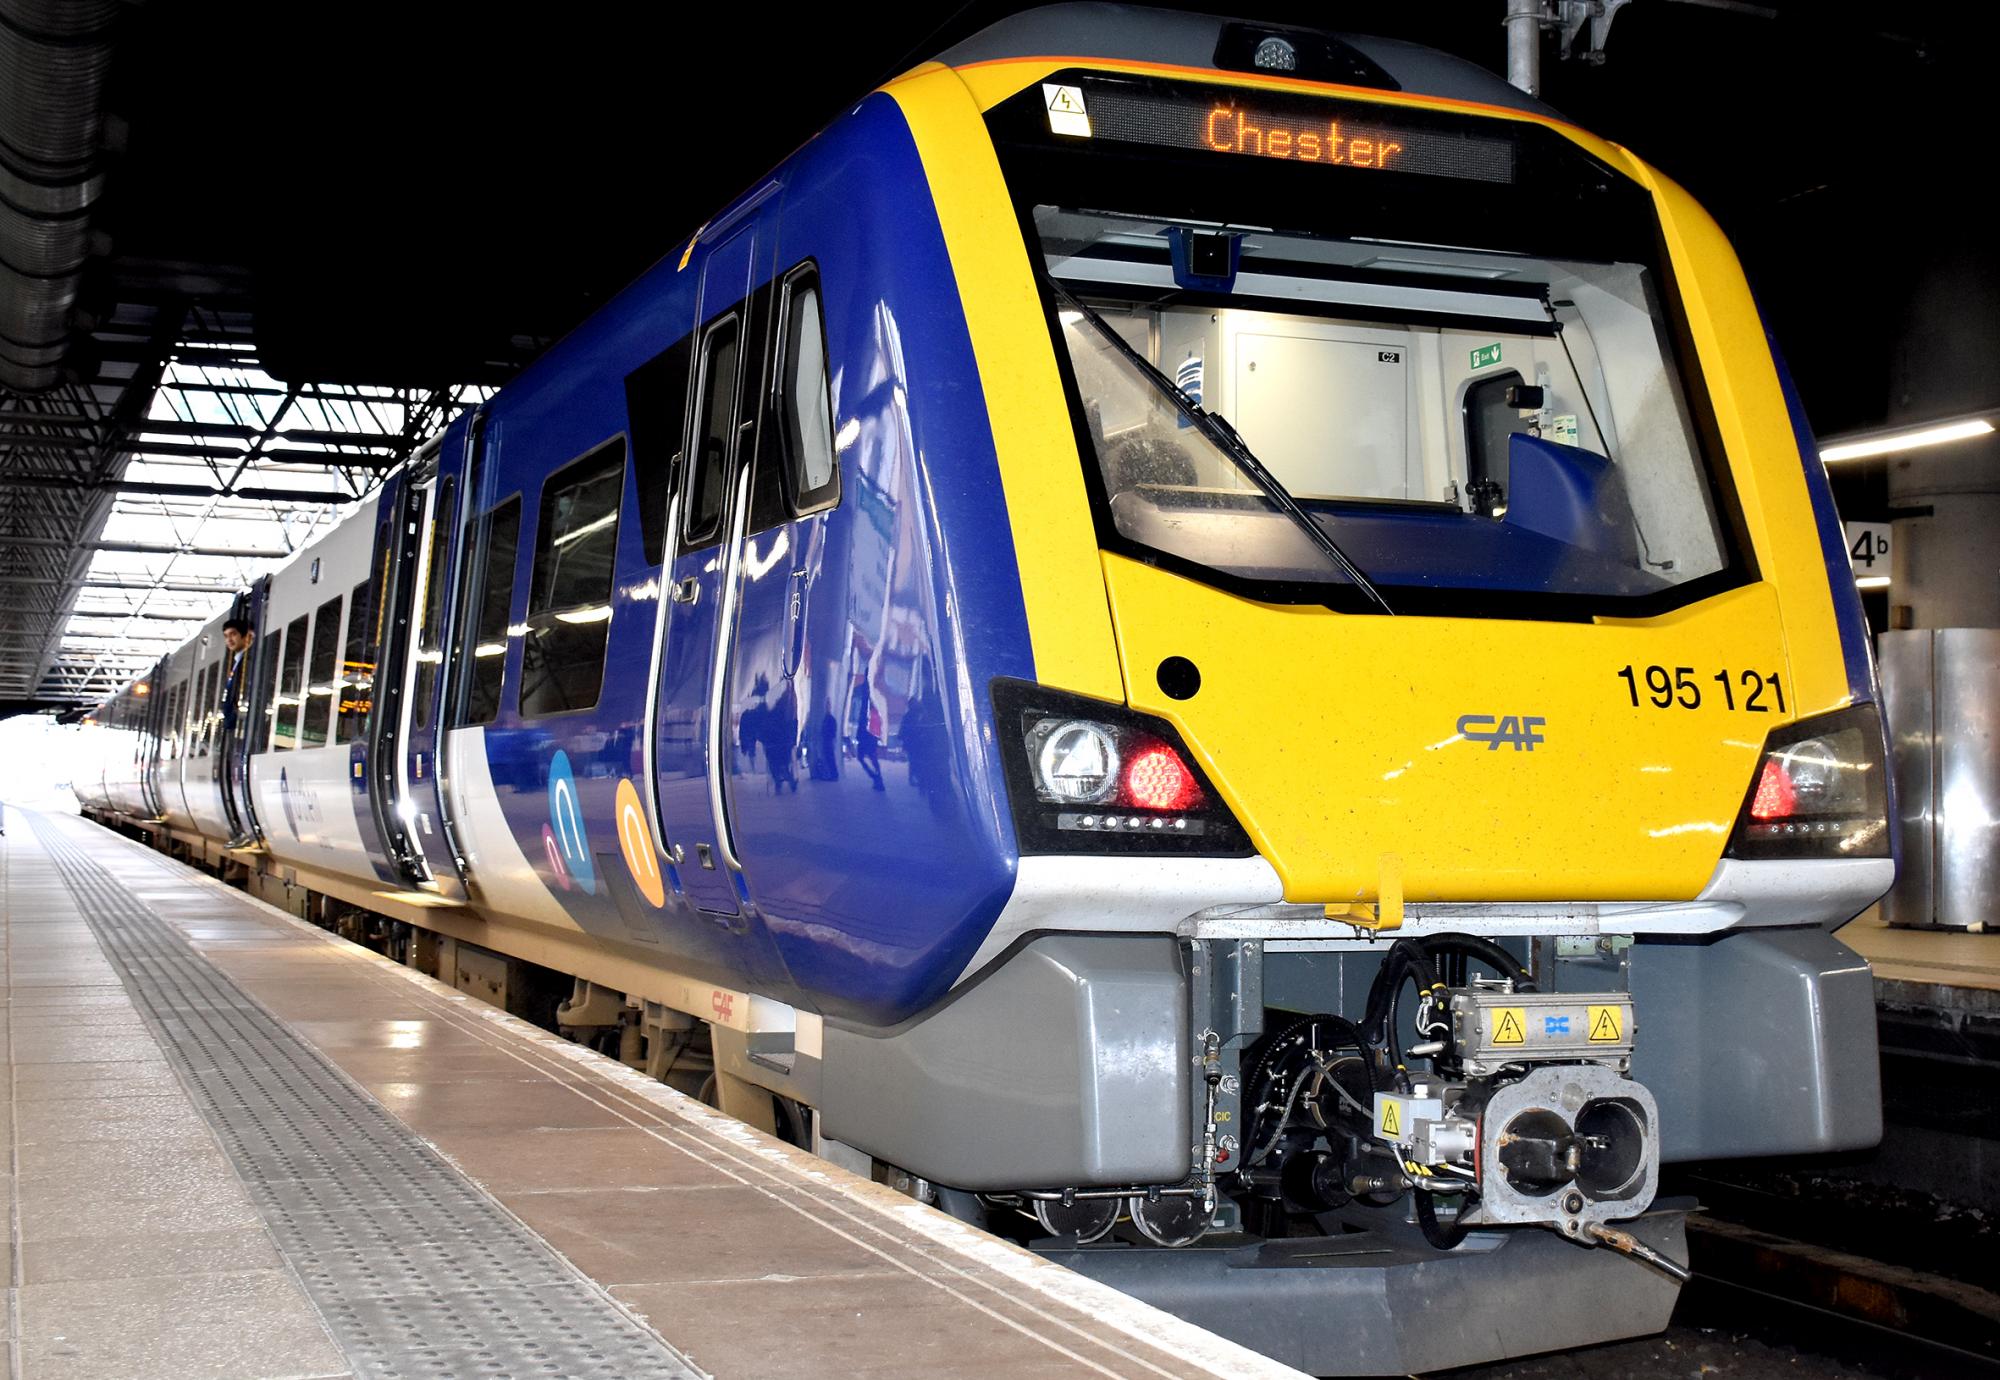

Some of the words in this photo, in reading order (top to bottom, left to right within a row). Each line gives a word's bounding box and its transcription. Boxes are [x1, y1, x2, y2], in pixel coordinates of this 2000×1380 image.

[1208, 109, 1400, 168] Chester
[1382, 352, 1396, 362] C2
[1851, 531, 1888, 567] 4b
[1617, 665, 1701, 710] 195
[1714, 669, 1786, 713] 121
[1456, 714, 1546, 751] CAF
[712, 990, 733, 1022] CAF
[1214, 1111, 1231, 1122] CIC
